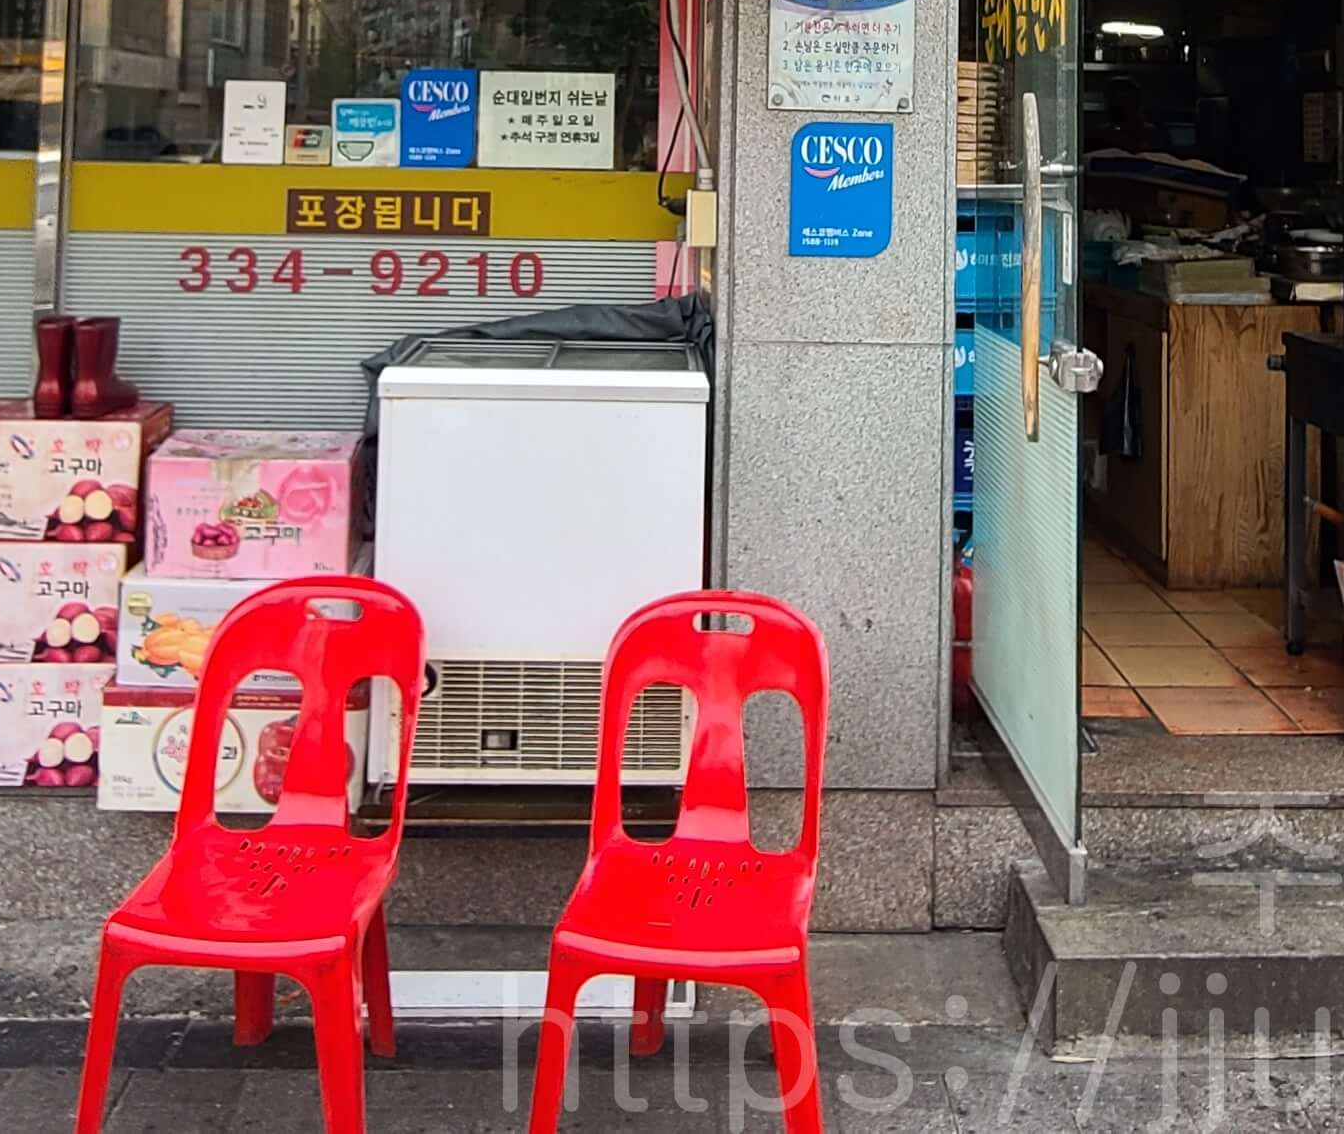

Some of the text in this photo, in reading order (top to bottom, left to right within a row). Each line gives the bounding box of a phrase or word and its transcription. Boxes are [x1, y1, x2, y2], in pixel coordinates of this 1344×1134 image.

[408, 79, 470, 104] CESCO
[492, 88, 609, 107] 순대일번지 쉬는날
[800, 134, 884, 165] CESCO
[827, 165, 885, 193] Members
[294, 194, 482, 231] 포장됩니다
[178, 245, 545, 299] 334-9210
[48, 457, 103, 476] 고구마
[243, 525, 304, 546] 고구마
[35, 579, 91, 600] 고구마
[27, 698, 83, 719] 고구마
